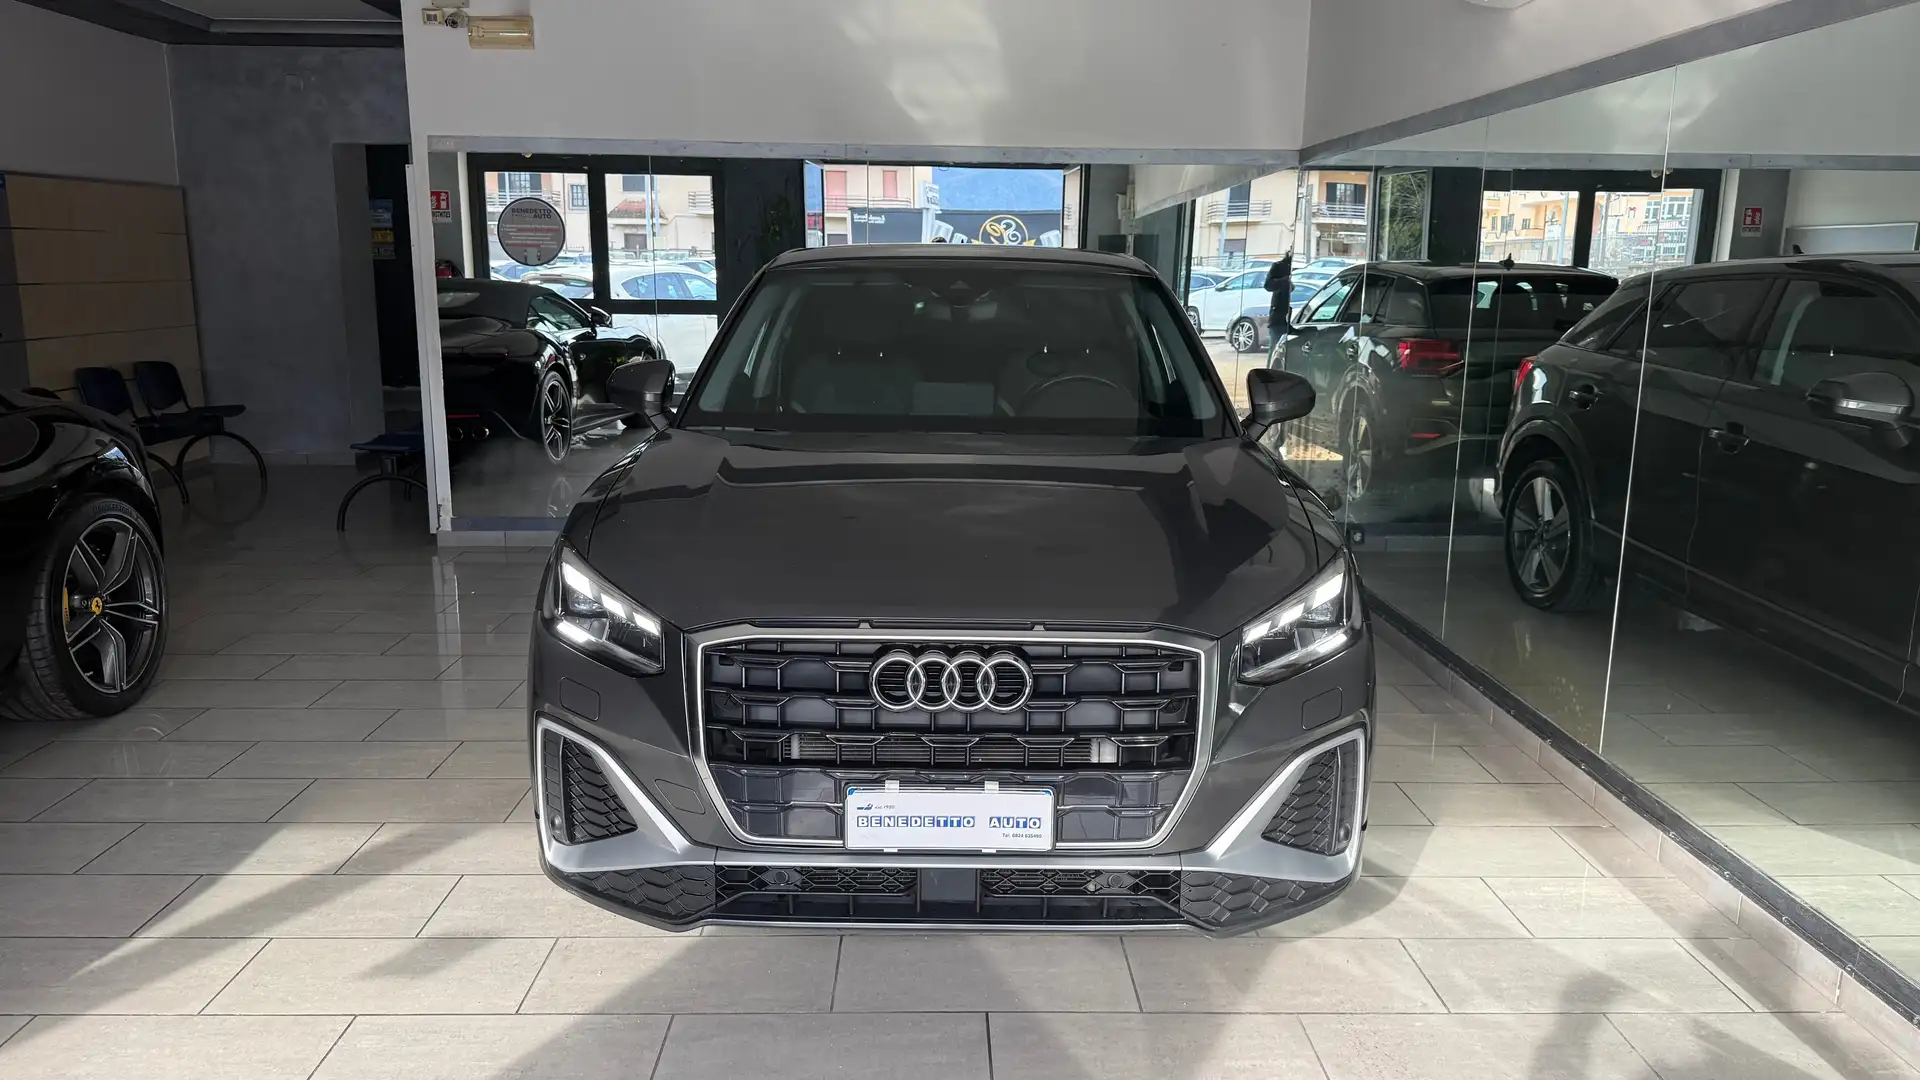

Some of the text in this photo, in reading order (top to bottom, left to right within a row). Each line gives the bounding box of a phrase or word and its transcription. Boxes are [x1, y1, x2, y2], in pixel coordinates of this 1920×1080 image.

[511, 207, 552, 215] BENEDETTO
[857, 815, 1042, 829] BENEDETTO AUTO
